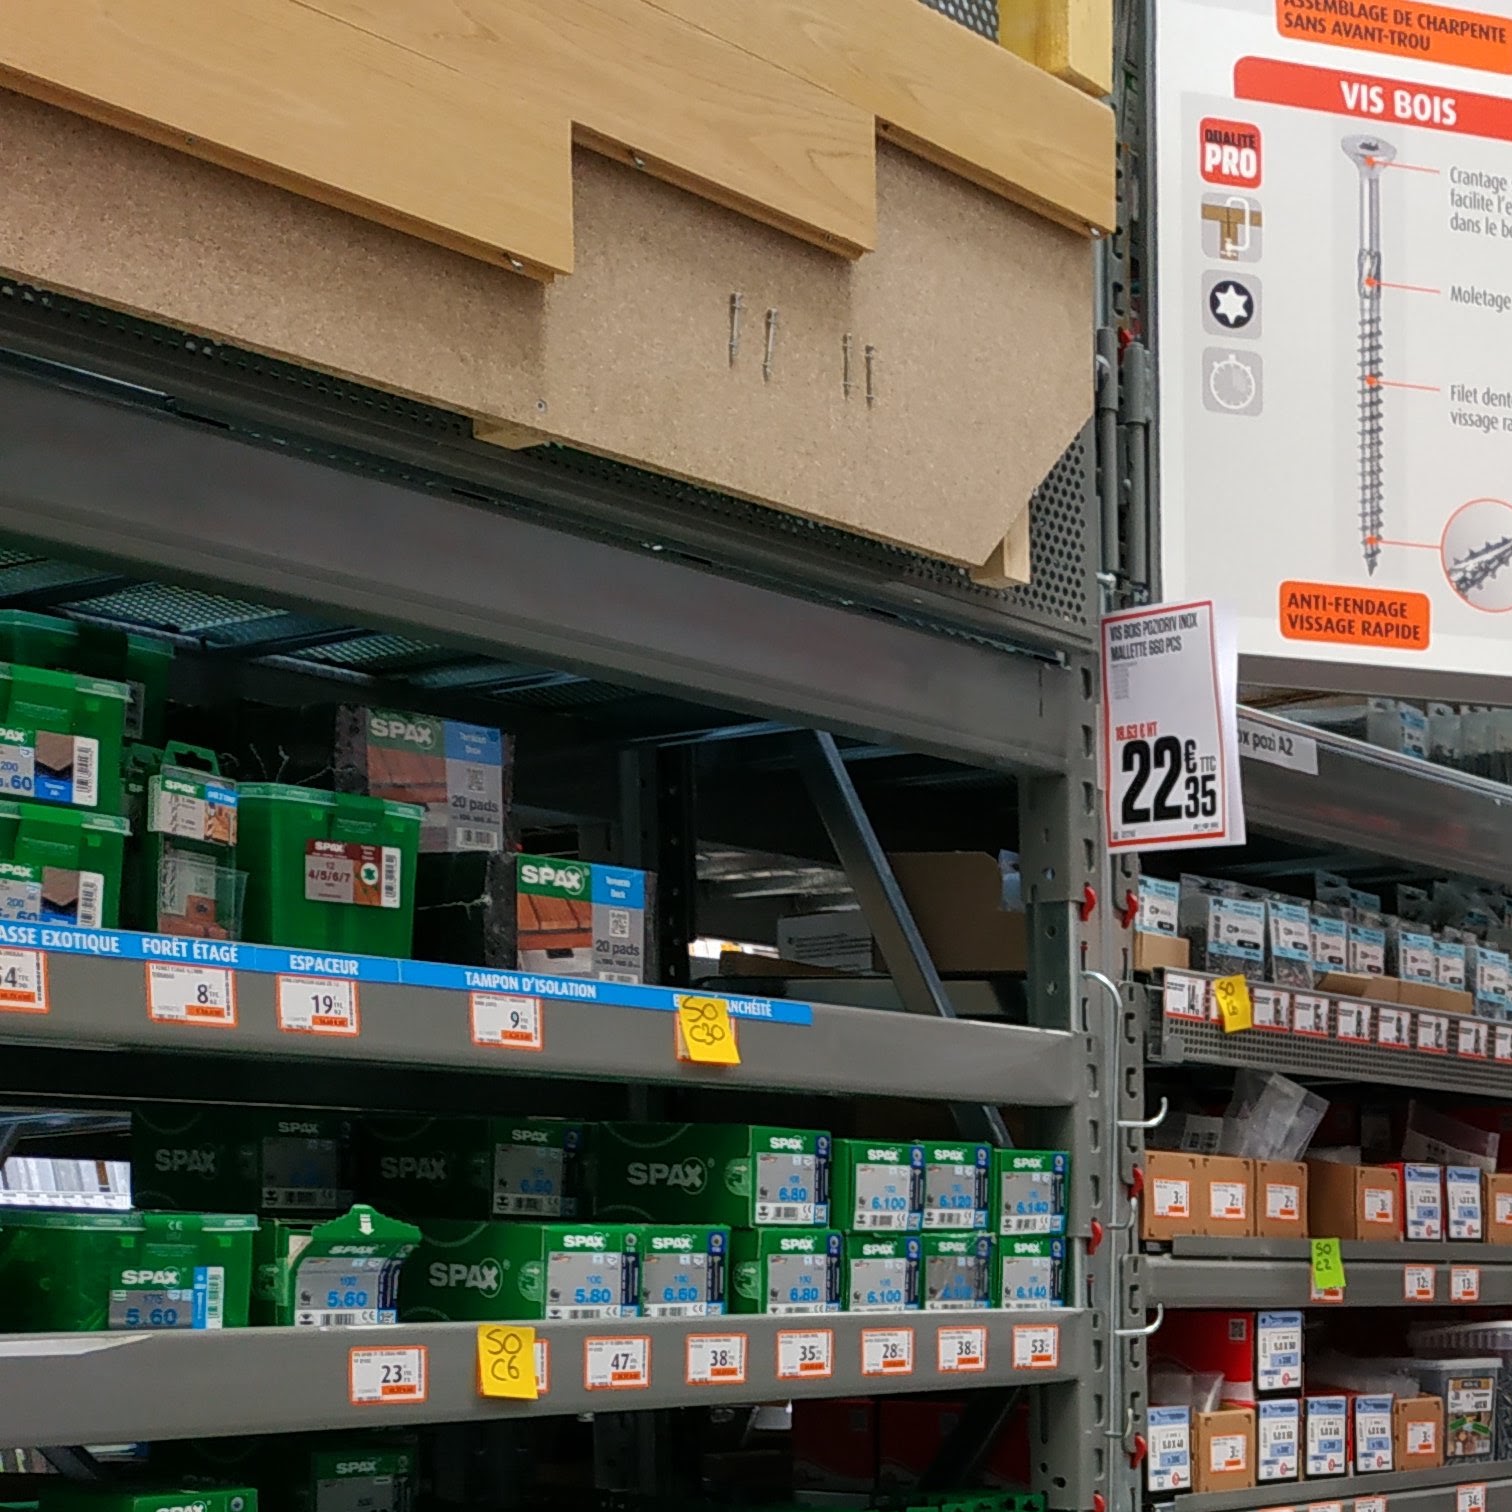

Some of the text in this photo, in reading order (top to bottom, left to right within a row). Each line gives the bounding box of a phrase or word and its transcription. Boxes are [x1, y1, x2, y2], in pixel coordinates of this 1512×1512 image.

[1285, 12, 1431, 51] SANS AVANT-TROU
[1394, 10, 1412, 27] DE
[1417, 13, 1506, 44] CHARPENTE
[1341, 80, 1457, 126] VIS BOIS
[1205, 143, 1257, 178] PRO
[1450, 166, 1507, 194] Crantage
[1450, 192, 1493, 213] facilite
[1450, 215, 1481, 235] dans
[1485, 218, 1499, 237] le
[1450, 286, 1511, 312] Moletage
[1450, 384, 1478, 404] Filet
[1450, 409, 1499, 434] vissage
[1288, 593, 1407, 620] ANTI-FENDAGE
[1288, 613, 1421, 641] VISSAGE RAPIDE
[1253, 730, 1294, 756] pozi A2
[1122, 736, 1216, 824] 22 € TTC
[1185, 774, 1216, 819] 35
[521, 864, 583, 891] SPAX
[41, 929, 120, 953] EXOTIQUE
[142, 937, 187, 958] FORÊT
[596, 940, 640, 959] 20 pads
[290, 954, 359, 976] ESPACEUR
[465, 971, 596, 999] TAMPON D'ISOLATION
[627, 1162, 702, 1188] SPAX
[122, 1267, 179, 1286] SPAX
[429, 1262, 499, 1289] SPAX
[381, 1364, 402, 1385] 23
[611, 1353, 630, 1370] 47
